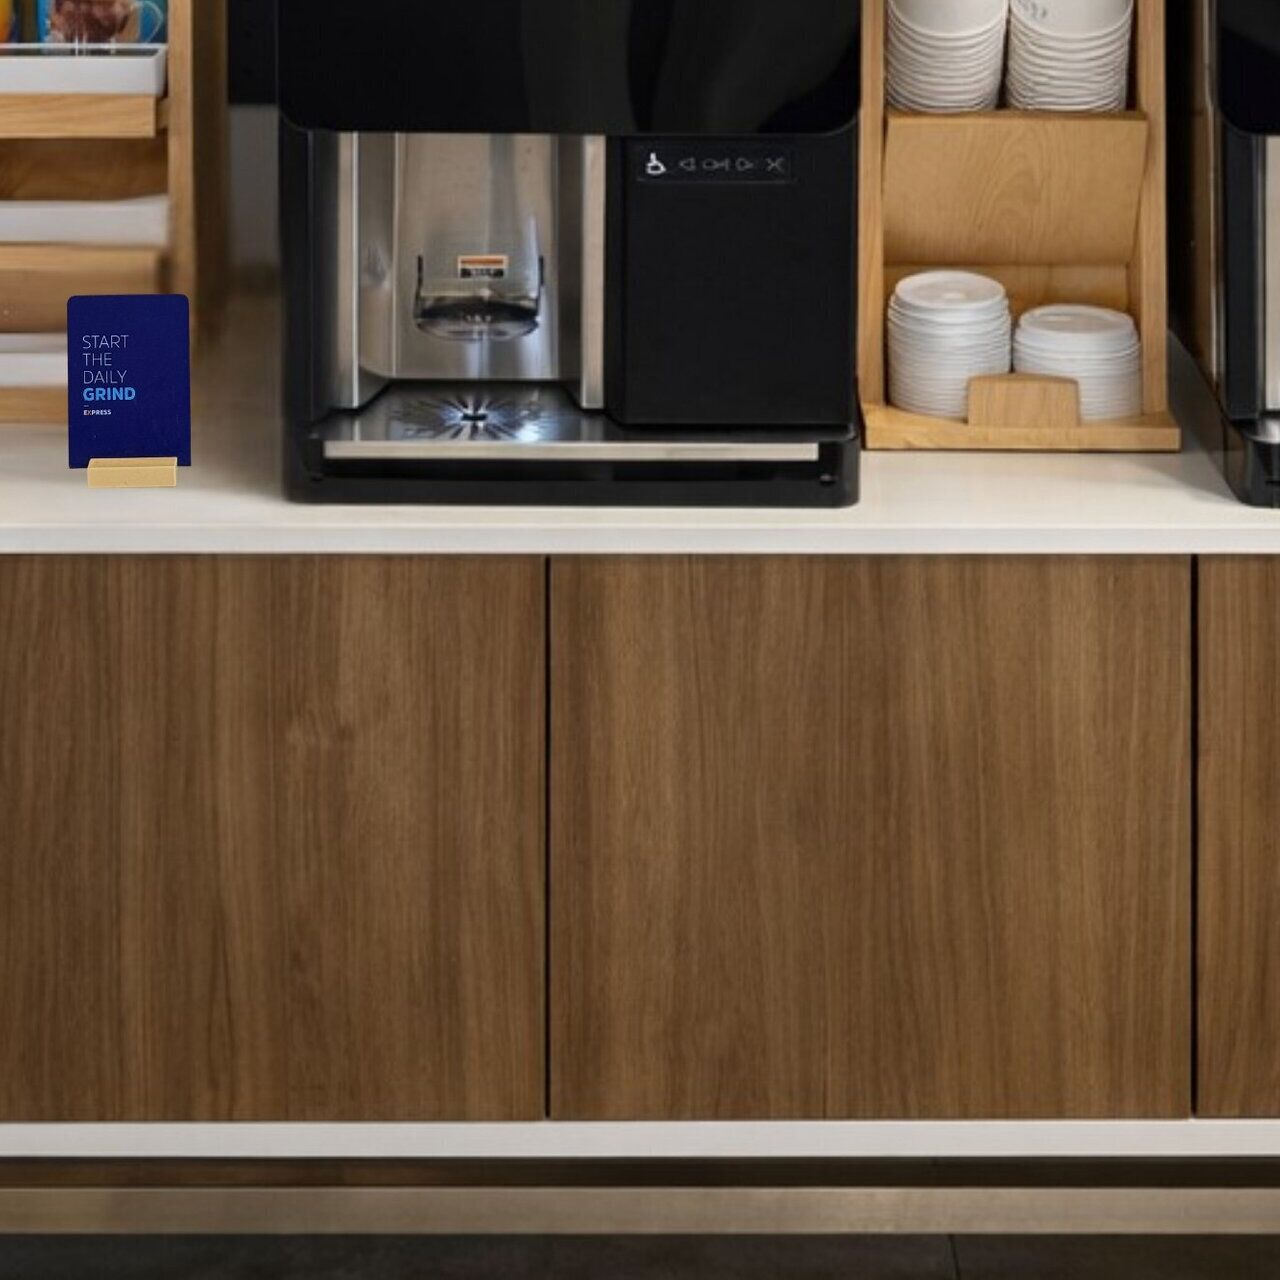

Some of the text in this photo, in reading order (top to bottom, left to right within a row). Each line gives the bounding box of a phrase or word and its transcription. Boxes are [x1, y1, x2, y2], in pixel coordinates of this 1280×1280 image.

[82, 335, 129, 349] START
[83, 353, 112, 366] THE
[83, 370, 127, 384] DAILY
[83, 387, 136, 401] GRIND
